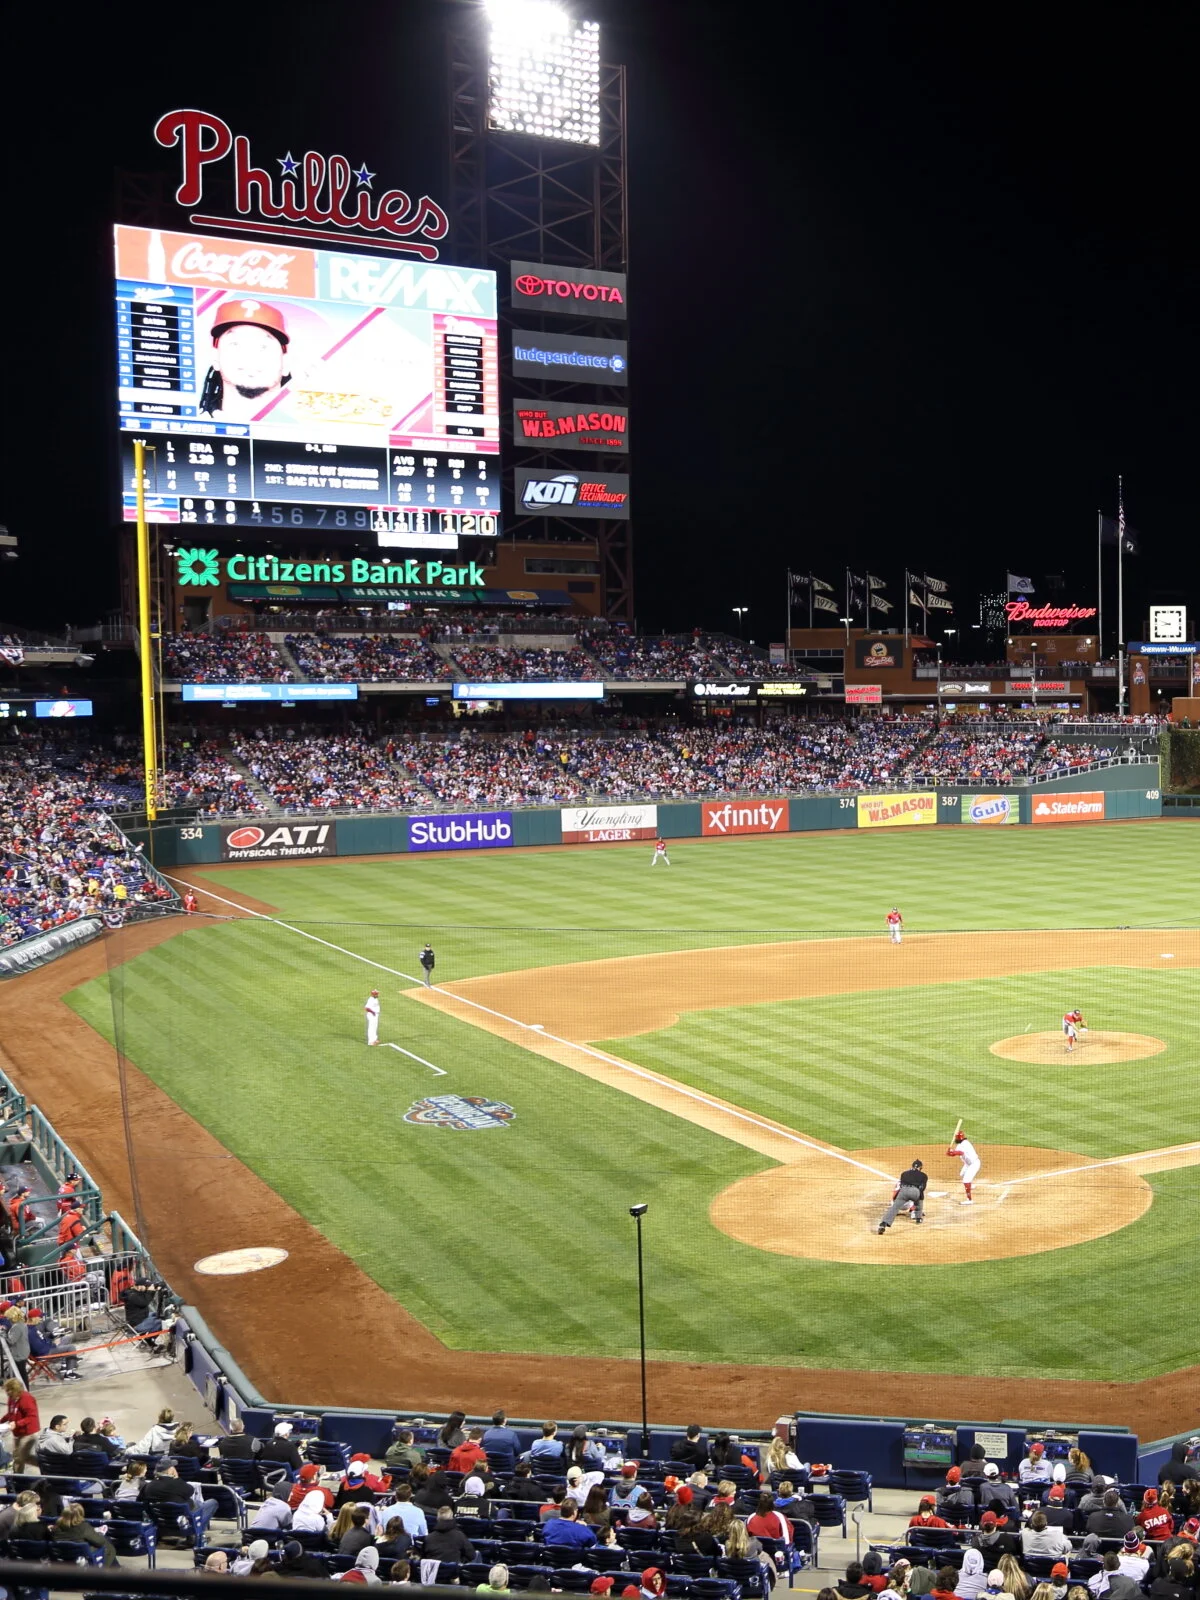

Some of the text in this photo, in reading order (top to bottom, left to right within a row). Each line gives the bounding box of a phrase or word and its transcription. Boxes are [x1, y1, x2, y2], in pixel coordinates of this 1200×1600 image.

[154, 109, 449, 240] Phillies
[171, 241, 298, 290] Coca-Cola
[329, 256, 490, 314] RE/MAX
[543, 279, 624, 304] TOYOTA
[514, 346, 609, 369] Independence
[518, 410, 548, 419] WHO BUT
[189, 443, 213, 453] ERA
[393, 456, 415, 466] AVG
[423, 457, 437, 467] HR
[194, 472, 210, 482] ER
[580, 483, 607, 493] OFFICE
[579, 491, 627, 503] TECHNOLOGY
[271, 507, 367, 527] 5 6 7 8 9
[462, 516, 475, 533] 2
[226, 556, 486, 587] Citizens Bank Park
[353, 587, 409, 598] HARRY
[1005, 601, 1096, 621] Budweiser
[1033, 619, 1069, 627] ROOFTOP
[1140, 645, 1197, 653] SHERWIN-WILLIAMS
[702, 683, 750, 696] NovaCare
[941, 796, 958, 806] 387
[1145, 790, 1159, 800] 409
[839, 798, 855, 809] 374
[972, 800, 1007, 818] Gulf
[575, 807, 642, 828] Yuengling
[708, 803, 784, 833] xfinity
[180, 827, 203, 840] 334
[261, 825, 330, 847] ATI
[410, 818, 512, 845] StubHub
[588, 829, 631, 842] LAGER
[229, 846, 324, 859] PHYSICAL THERAPY
[1144, 1513, 1168, 1530] STAFF
